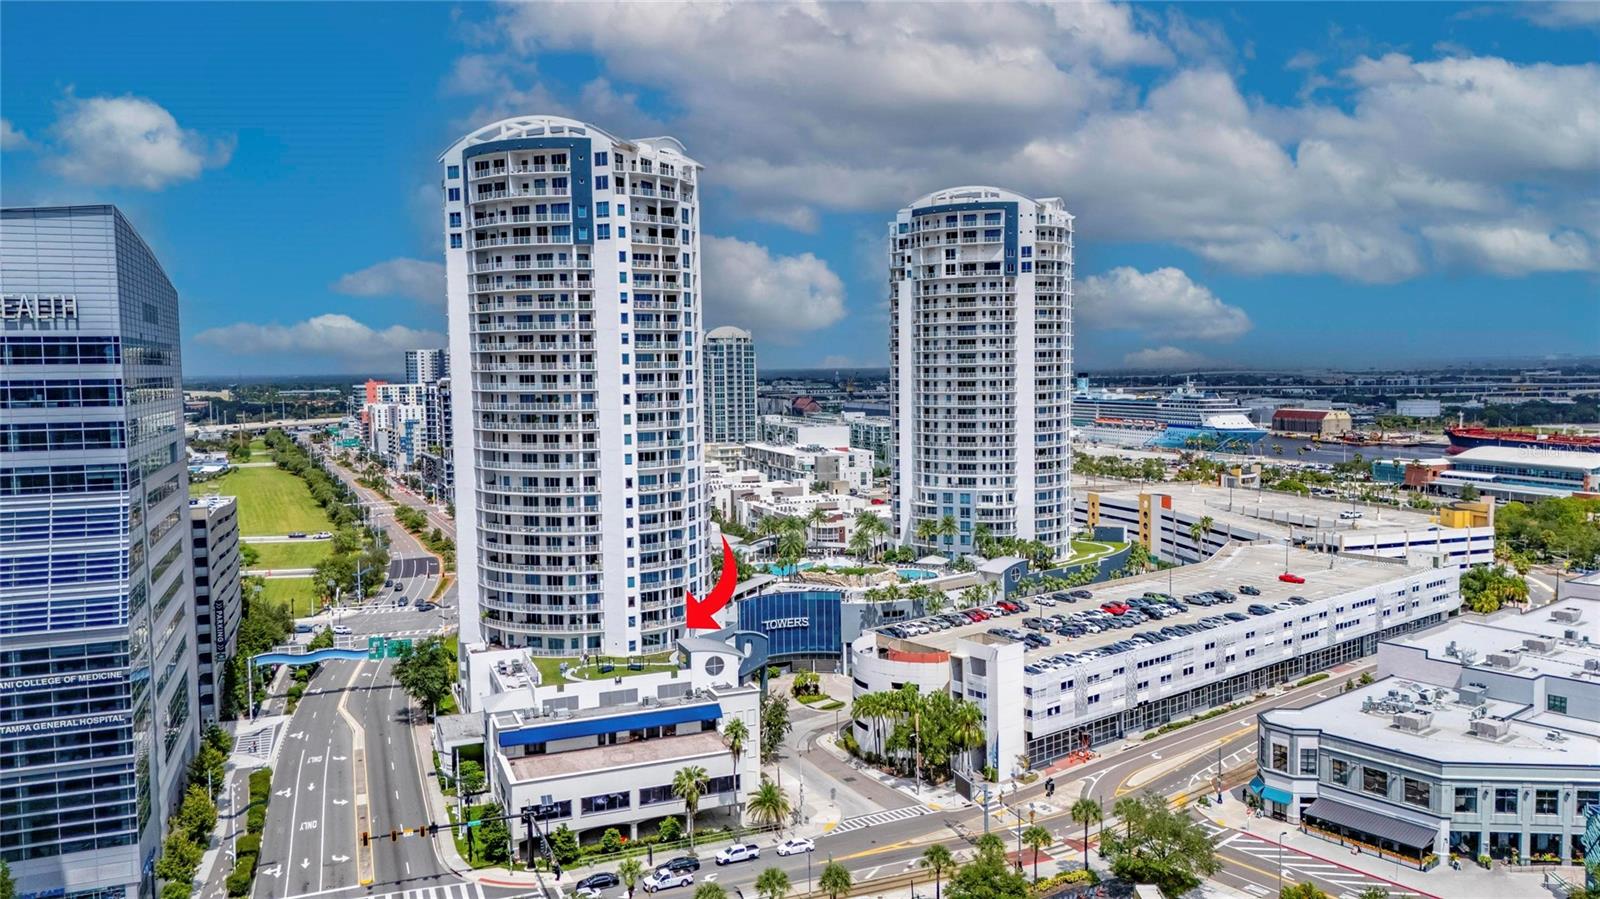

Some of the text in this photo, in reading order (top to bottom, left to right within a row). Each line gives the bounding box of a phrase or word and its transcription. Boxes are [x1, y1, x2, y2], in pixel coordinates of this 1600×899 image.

[0, 294, 77, 319] EALTH
[216, 610, 224, 643] PARKING
[761, 616, 810, 630] TOWERS
[16, 677, 61, 688] COLLEGE
[63, 675, 77, 684] OF
[78, 671, 123, 682] MEDICINE
[0, 714, 126, 735] TAMPA GENERAL HOSPITAL
[300, 820, 318, 831] ONLY
